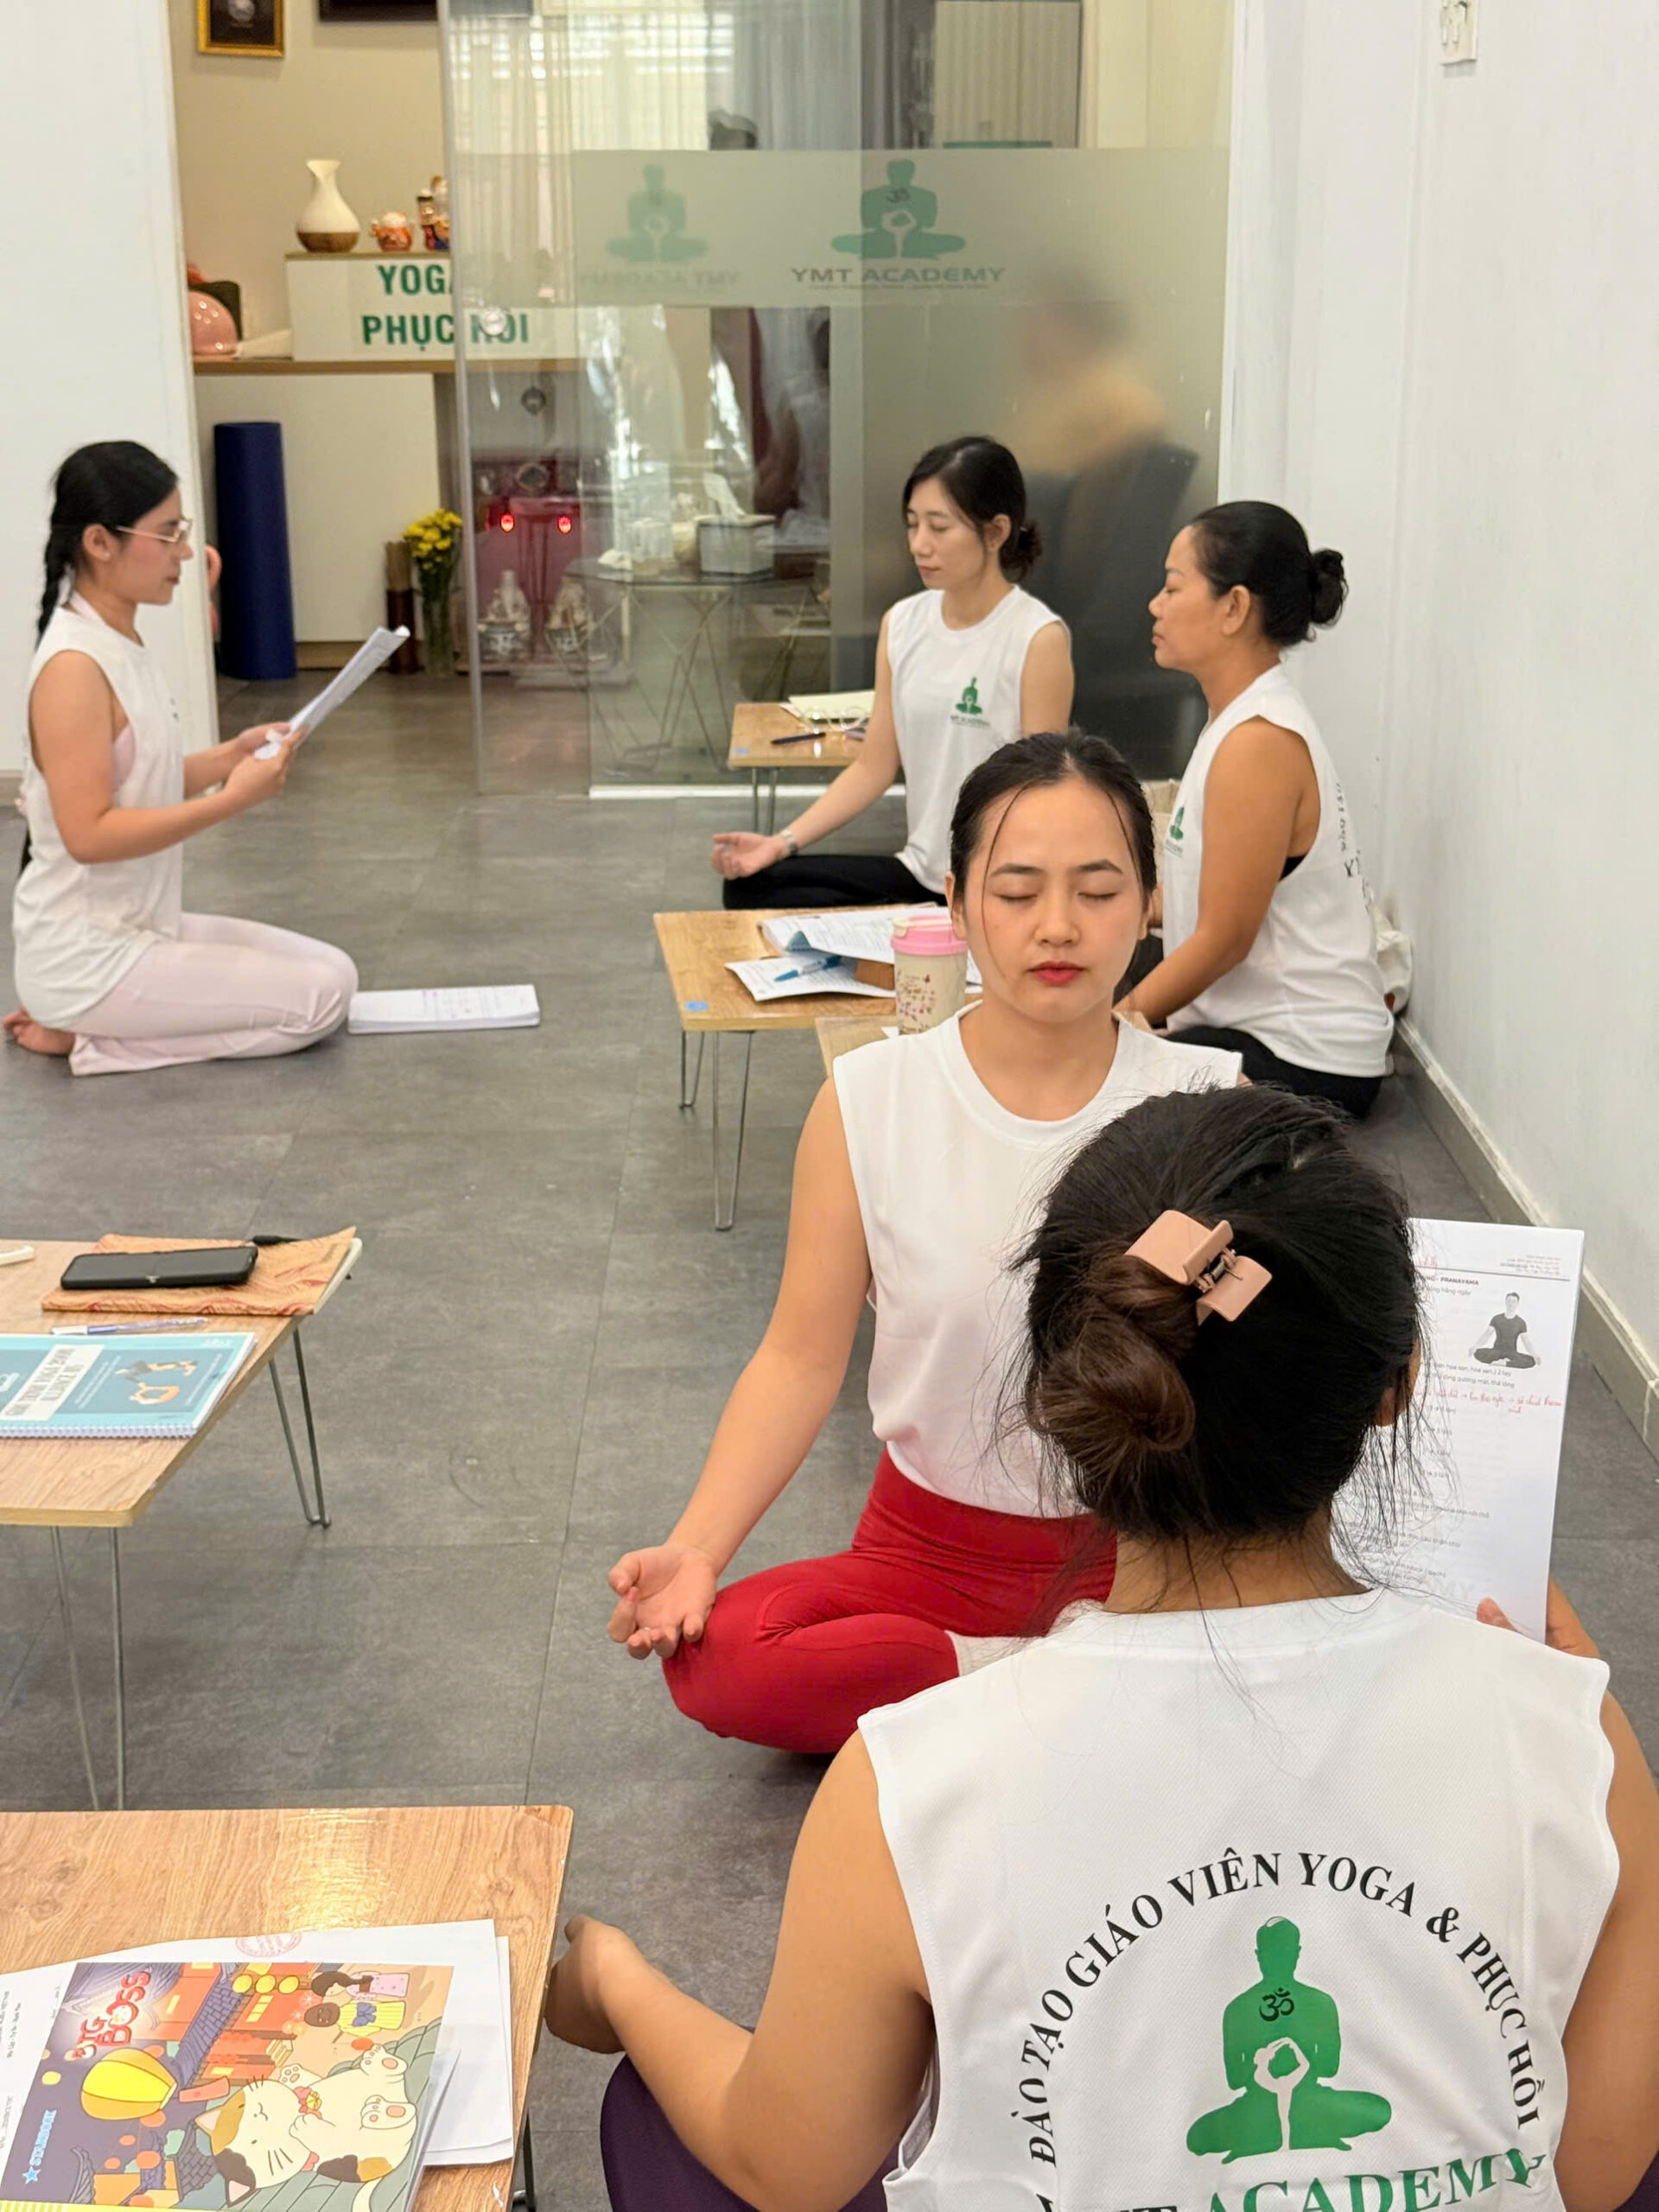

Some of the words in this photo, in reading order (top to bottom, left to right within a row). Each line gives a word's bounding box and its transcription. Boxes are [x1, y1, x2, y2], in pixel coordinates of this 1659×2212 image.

[377, 264, 454, 296] YOG
[791, 268, 853, 283] YMT
[862, 267, 1007, 283] ACADEMY
[361, 314, 454, 352] PHỤC
[1166, 1847, 1282, 1907] VIÊN
[1297, 1851, 1415, 1917] YOGA
[1065, 1894, 1164, 1987] GIÁO
[1425, 1906, 1460, 1943] &
[96, 1970, 152, 2048] BOSS
[1455, 1931, 1528, 2039] PHỤC
[1021, 1988, 1074, 2072] TẠO
[1507, 2038, 1545, 2130] HỒI
[1011, 2077, 1057, 2168] ĐÀO
